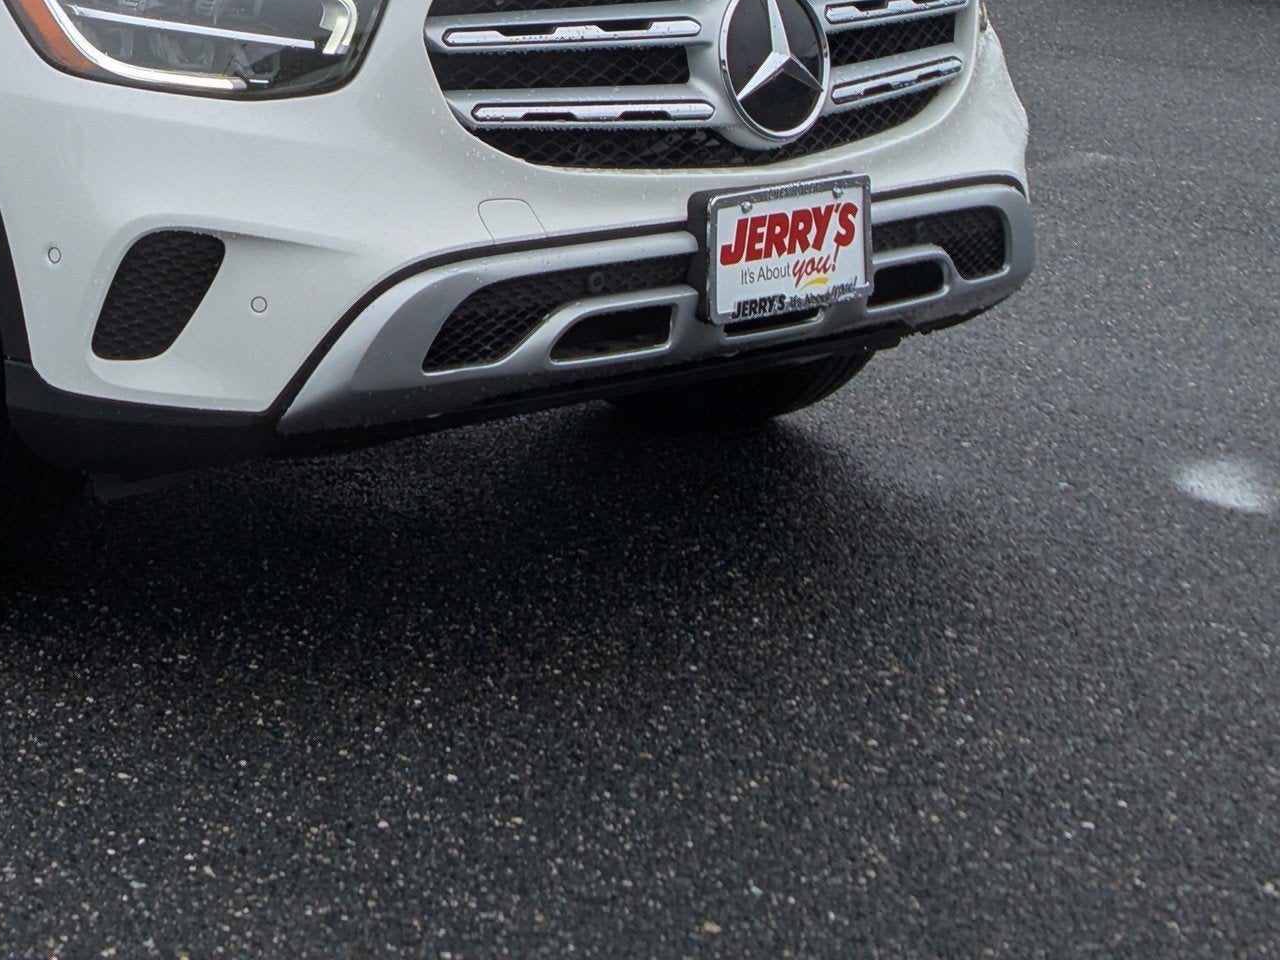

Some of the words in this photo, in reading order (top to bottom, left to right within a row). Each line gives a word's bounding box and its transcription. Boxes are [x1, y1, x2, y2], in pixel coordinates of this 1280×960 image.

[720, 202, 859, 266] JERRY'S
[741, 269, 755, 285] It's
[757, 264, 791, 283] About
[792, 246, 839, 288] you!
[731, 293, 787, 319] JERRY'S
